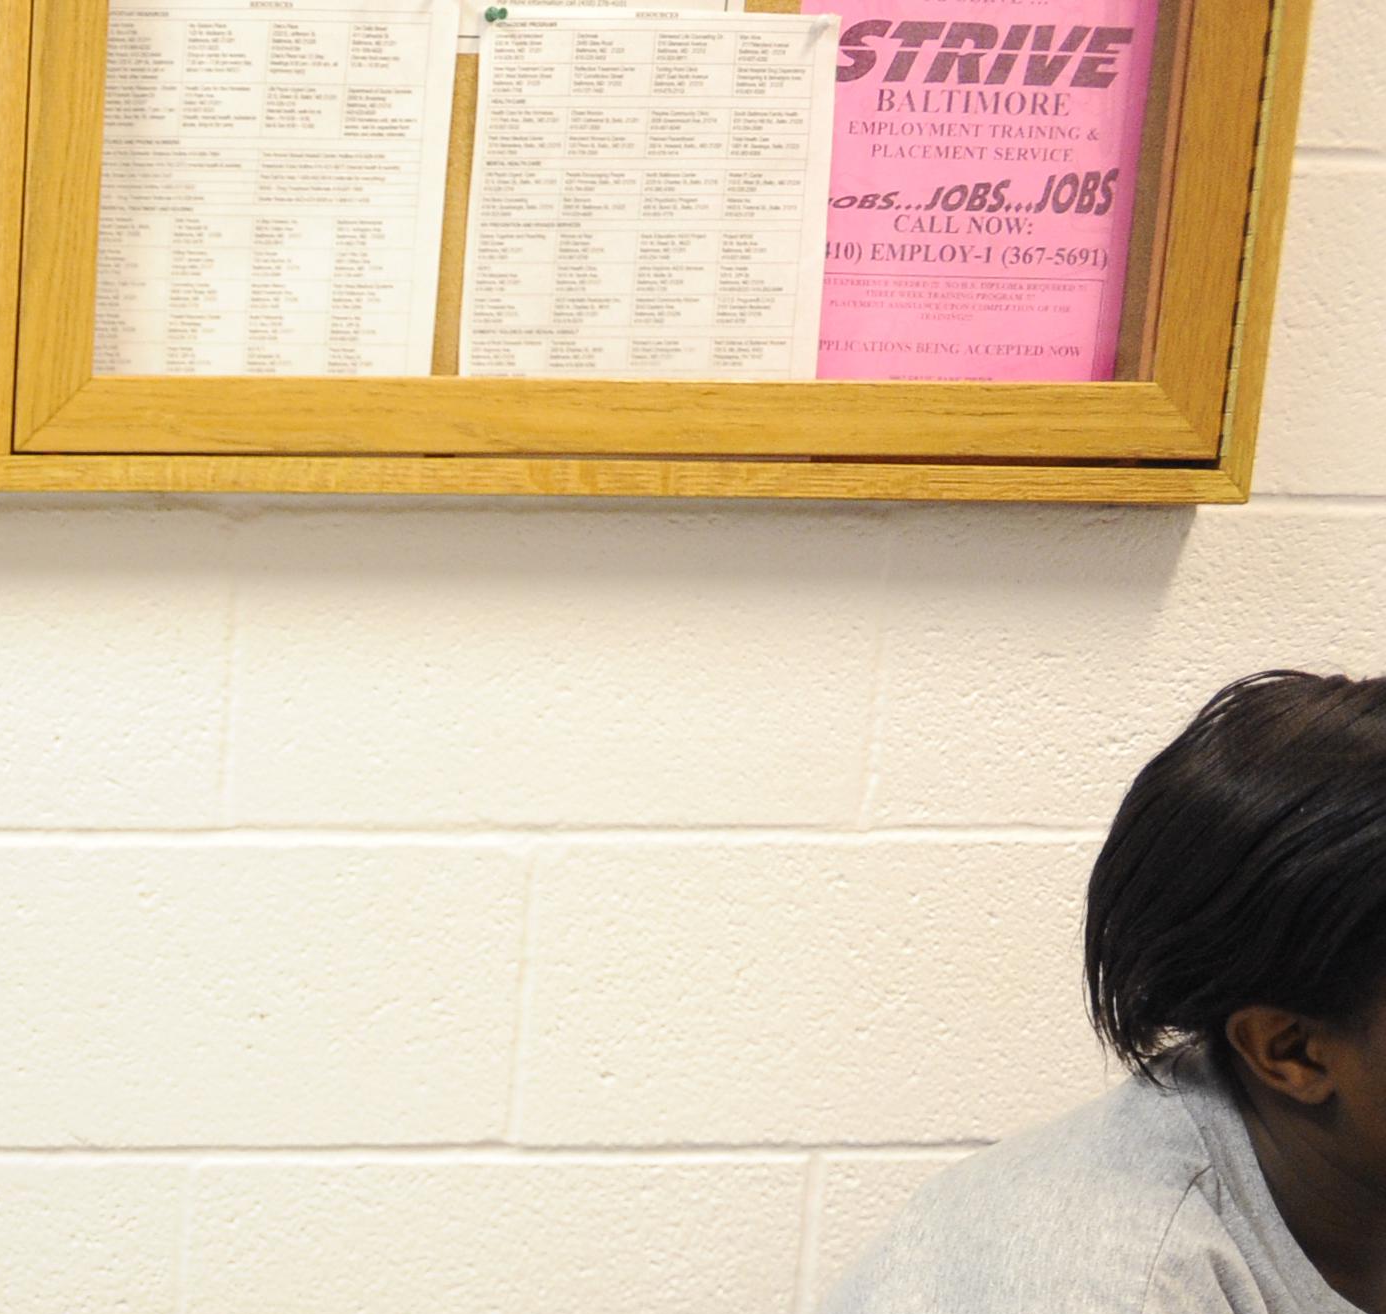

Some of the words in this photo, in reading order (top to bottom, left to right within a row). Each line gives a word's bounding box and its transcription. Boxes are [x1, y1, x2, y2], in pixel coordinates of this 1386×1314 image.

[835, 19, 1134, 89] STRIVE
[876, 88, 1071, 117] BALTIMORE
[847, 121, 982, 140] EMPLOYMENT
[988, 124, 1081, 141] TRAINING
[1086, 128, 1100, 142] &
[870, 143, 988, 161] PLACEMENT
[993, 147, 1074, 163] SERVICE
[829, 168, 1120, 216] OBS...JOBS...JOBS
[893, 214, 960, 234] CALL
[966, 216, 1034, 236] NOW:
[870, 243, 993, 264] EMPLOY-1
[1001, 247, 1108, 271] (367-5691)
[819, 339, 911, 353] PPLICATIONS
[915, 342, 959, 354] BEING
[964, 343, 1044, 356] ACCEPTED
[1050, 345, 1080, 357] NOW
